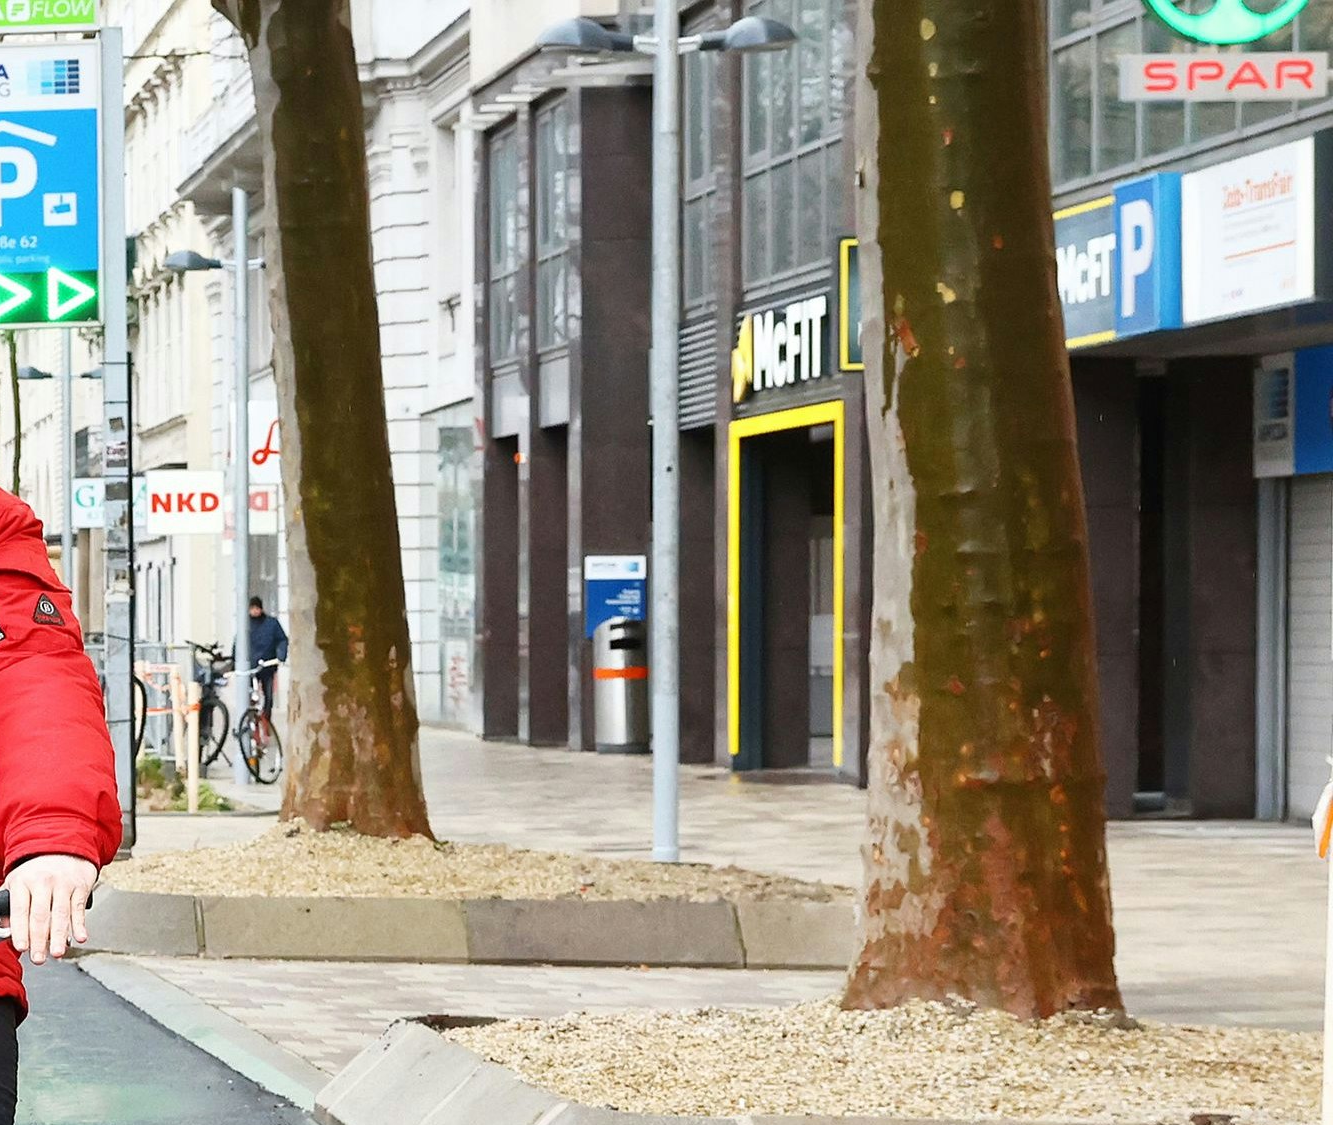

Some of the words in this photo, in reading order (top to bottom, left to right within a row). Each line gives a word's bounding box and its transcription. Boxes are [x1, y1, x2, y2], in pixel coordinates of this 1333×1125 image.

[32, 0, 93, 19] FLOW
[1144, 60, 1315, 92] SPAR
[19, 235, 38, 249] 62
[1120, 198, 1154, 318] P
[753, 295, 827, 392] McFIT
[151, 492, 219, 514] NKD
